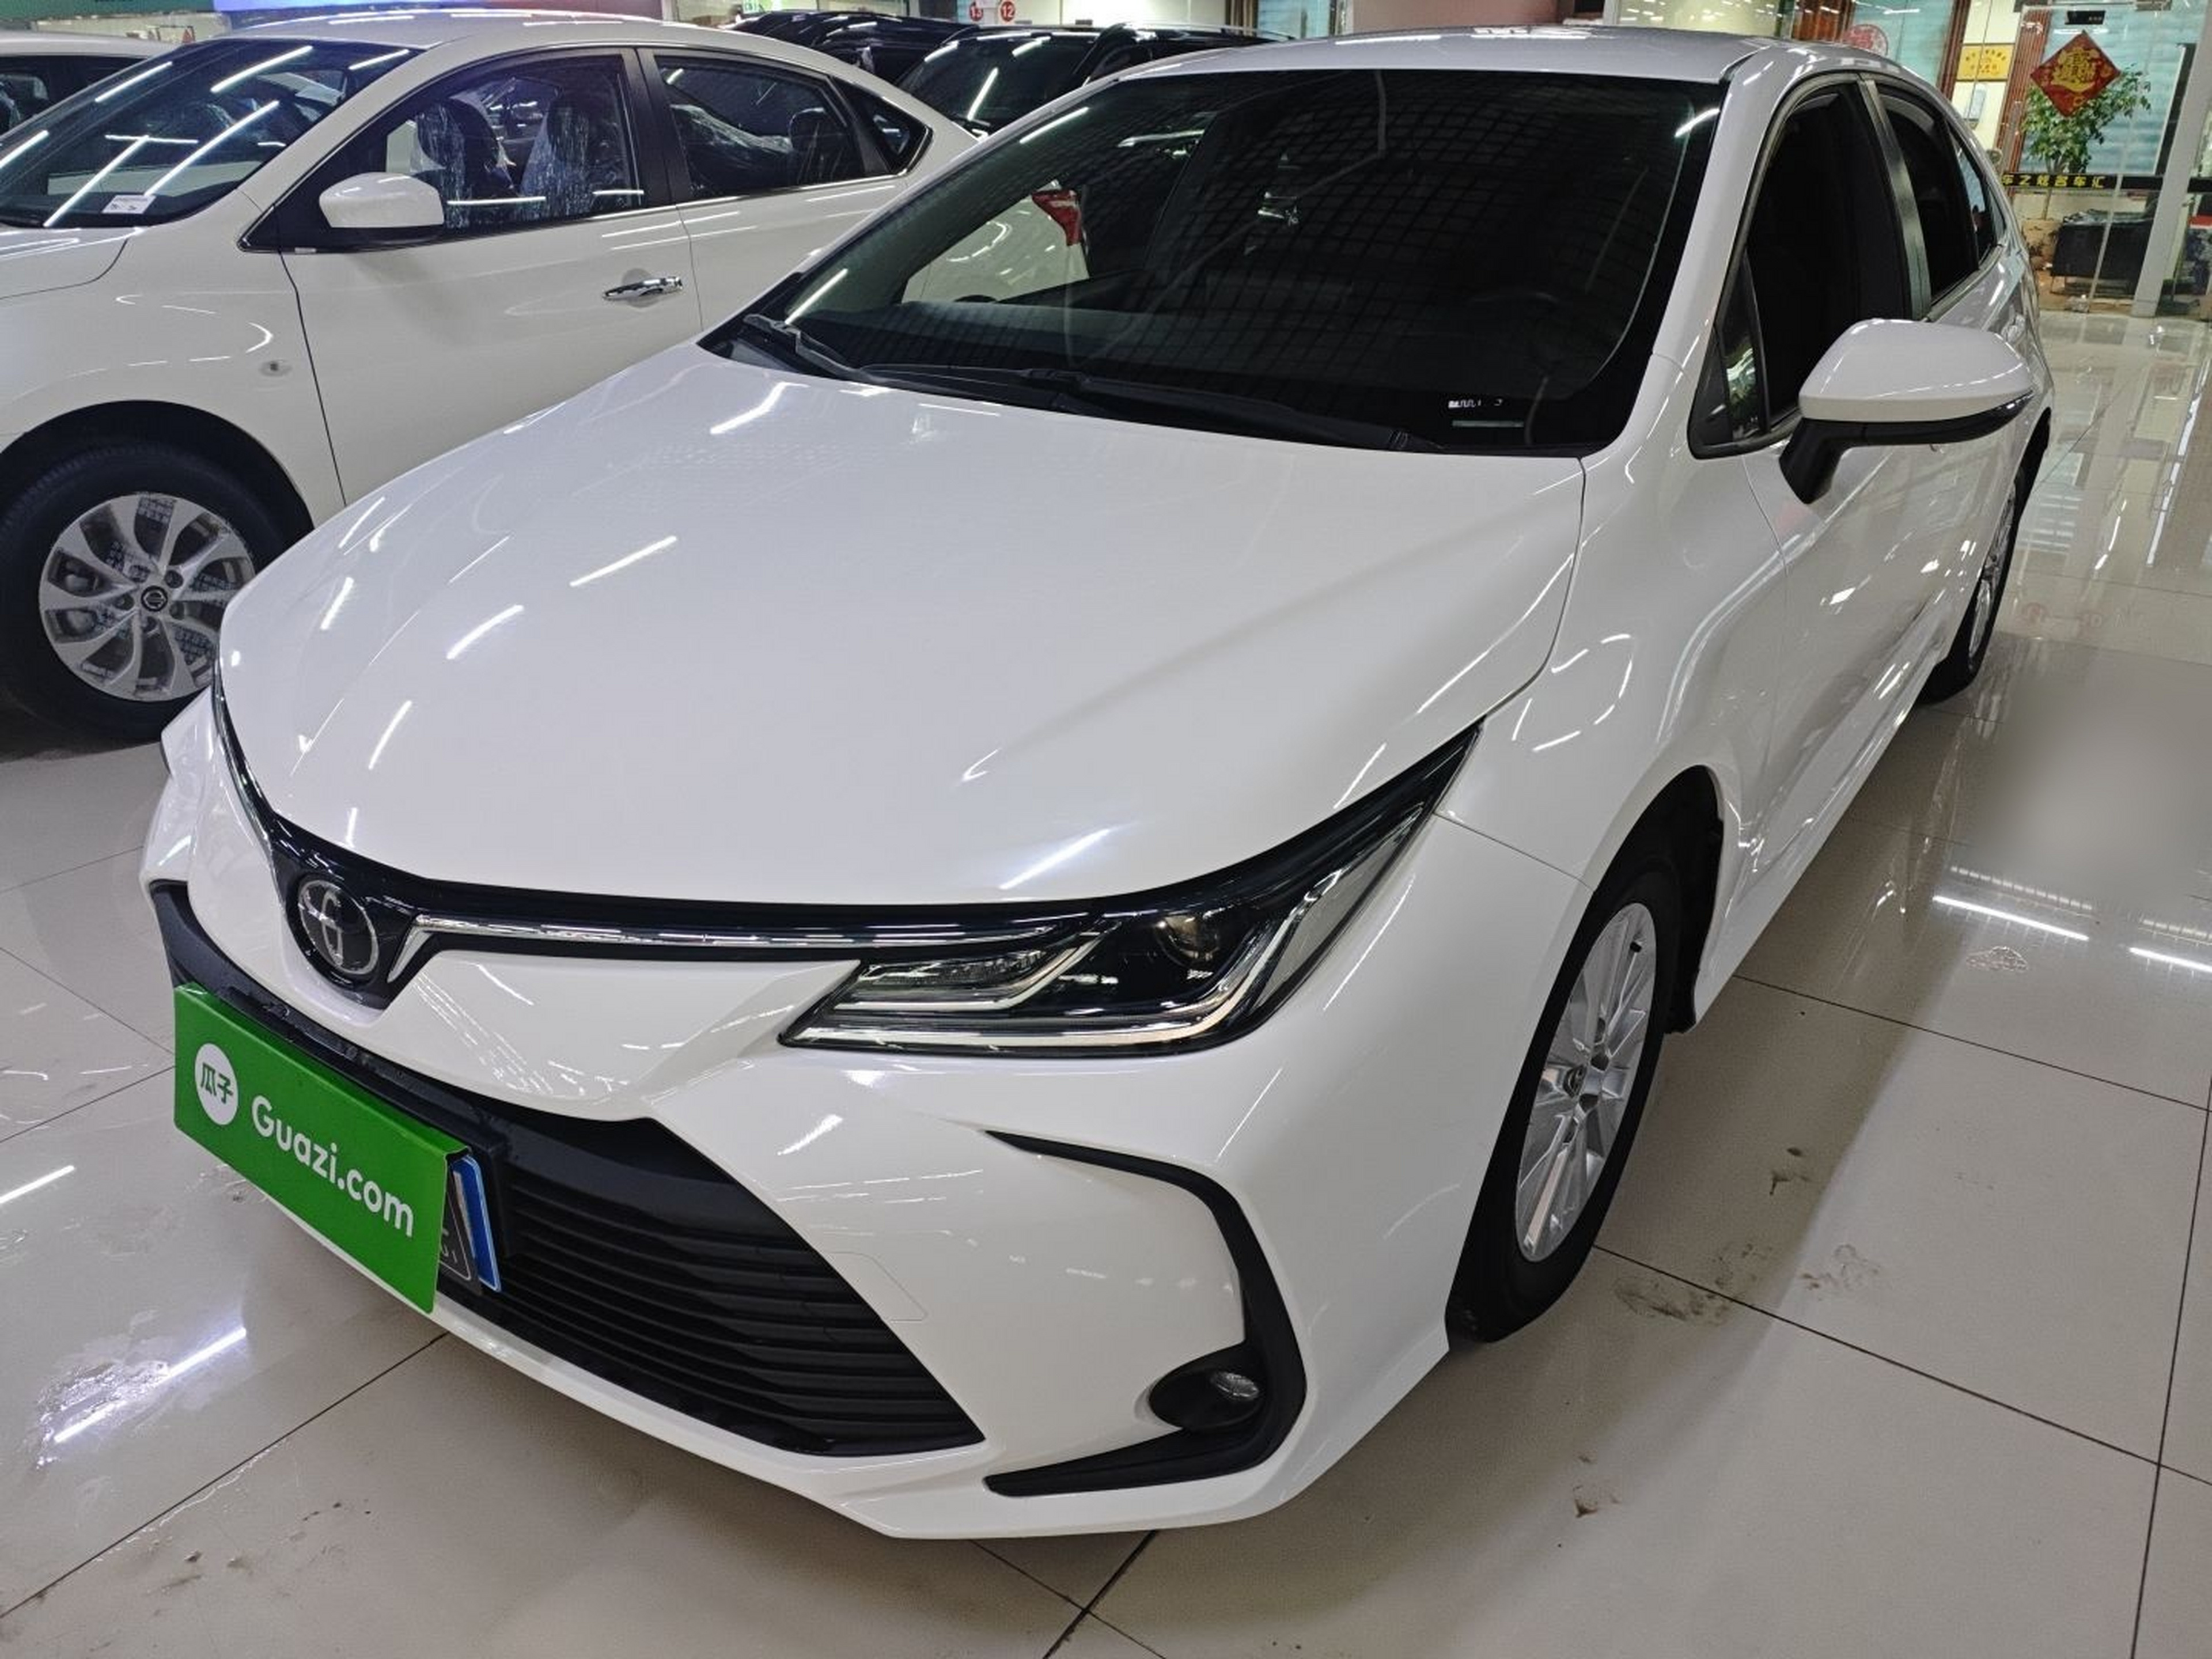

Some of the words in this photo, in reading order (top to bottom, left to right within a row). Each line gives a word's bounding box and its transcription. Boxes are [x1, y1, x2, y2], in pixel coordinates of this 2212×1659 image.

[1003, 5, 1013, 17] 12
[200, 1062, 234, 1104] 瓜子
[251, 1094, 414, 1237] Guazi.com
